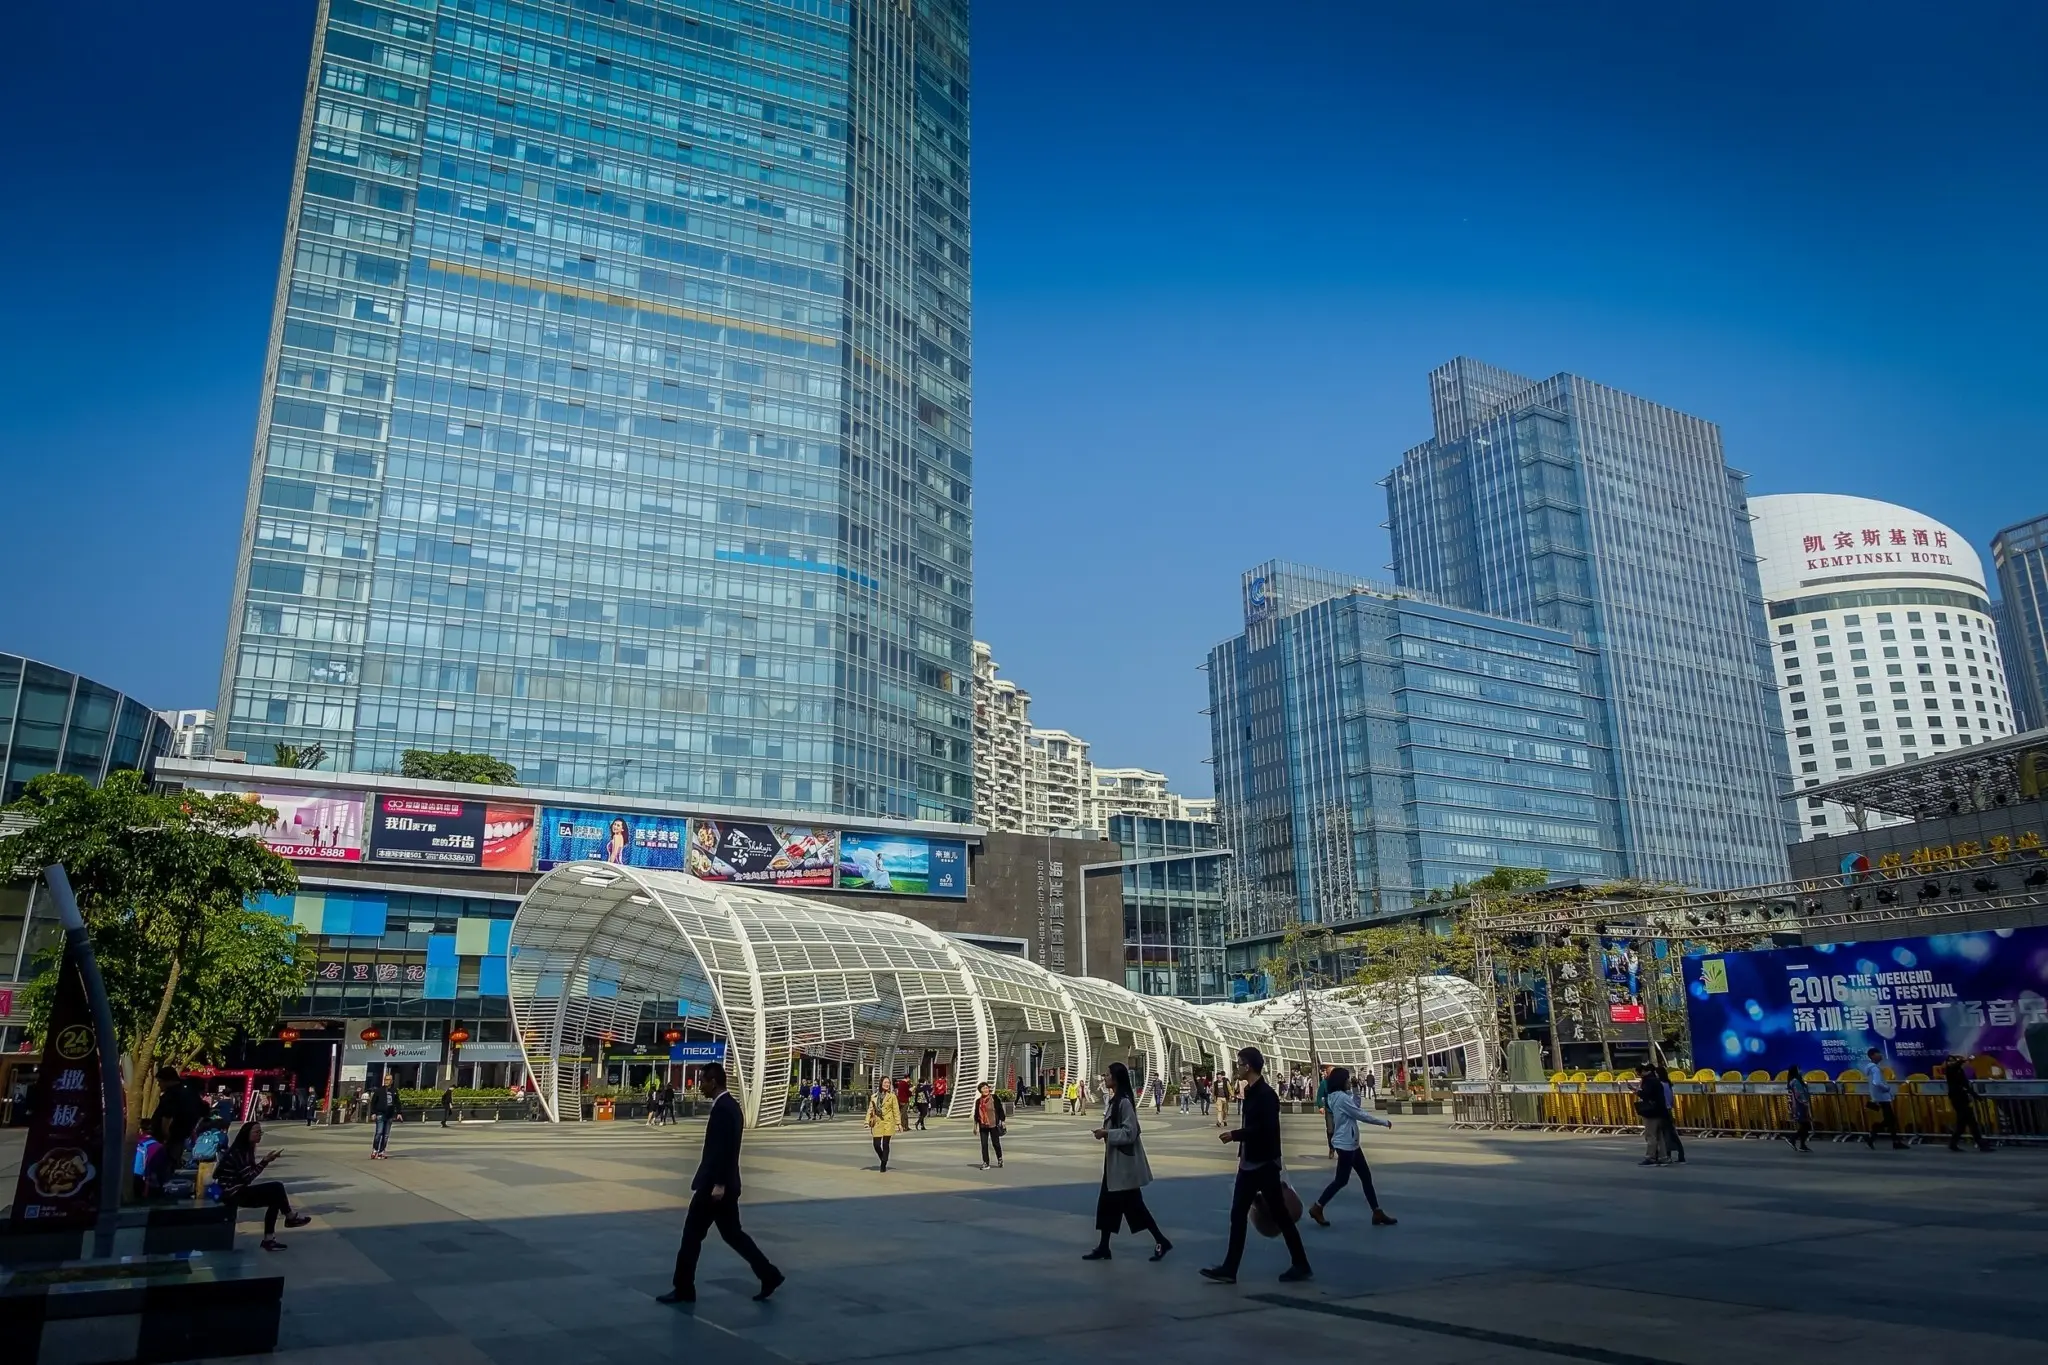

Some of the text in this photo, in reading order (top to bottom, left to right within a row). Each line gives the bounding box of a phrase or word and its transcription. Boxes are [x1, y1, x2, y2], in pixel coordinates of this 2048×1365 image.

[1803, 528, 1948, 553] 凯宾斯基酒店
[1807, 552, 1953, 570] KEMPINSKI HOTEL
[385, 817, 437, 832] 我们更了解
[560, 826, 572, 836] EA
[431, 834, 475, 848] 您的牙齿
[635, 829, 679, 842] 医学美容
[273, 845, 346, 857] 400-690-5888
[1848, 970, 1933, 987] THE WEEKEND
[1789, 974, 1849, 1004] 2016
[1850, 983, 1958, 1001] MUSIC FESTIVAL
[63, 1030, 89, 1048] 24
[682, 1047, 716, 1055] MEIZU
